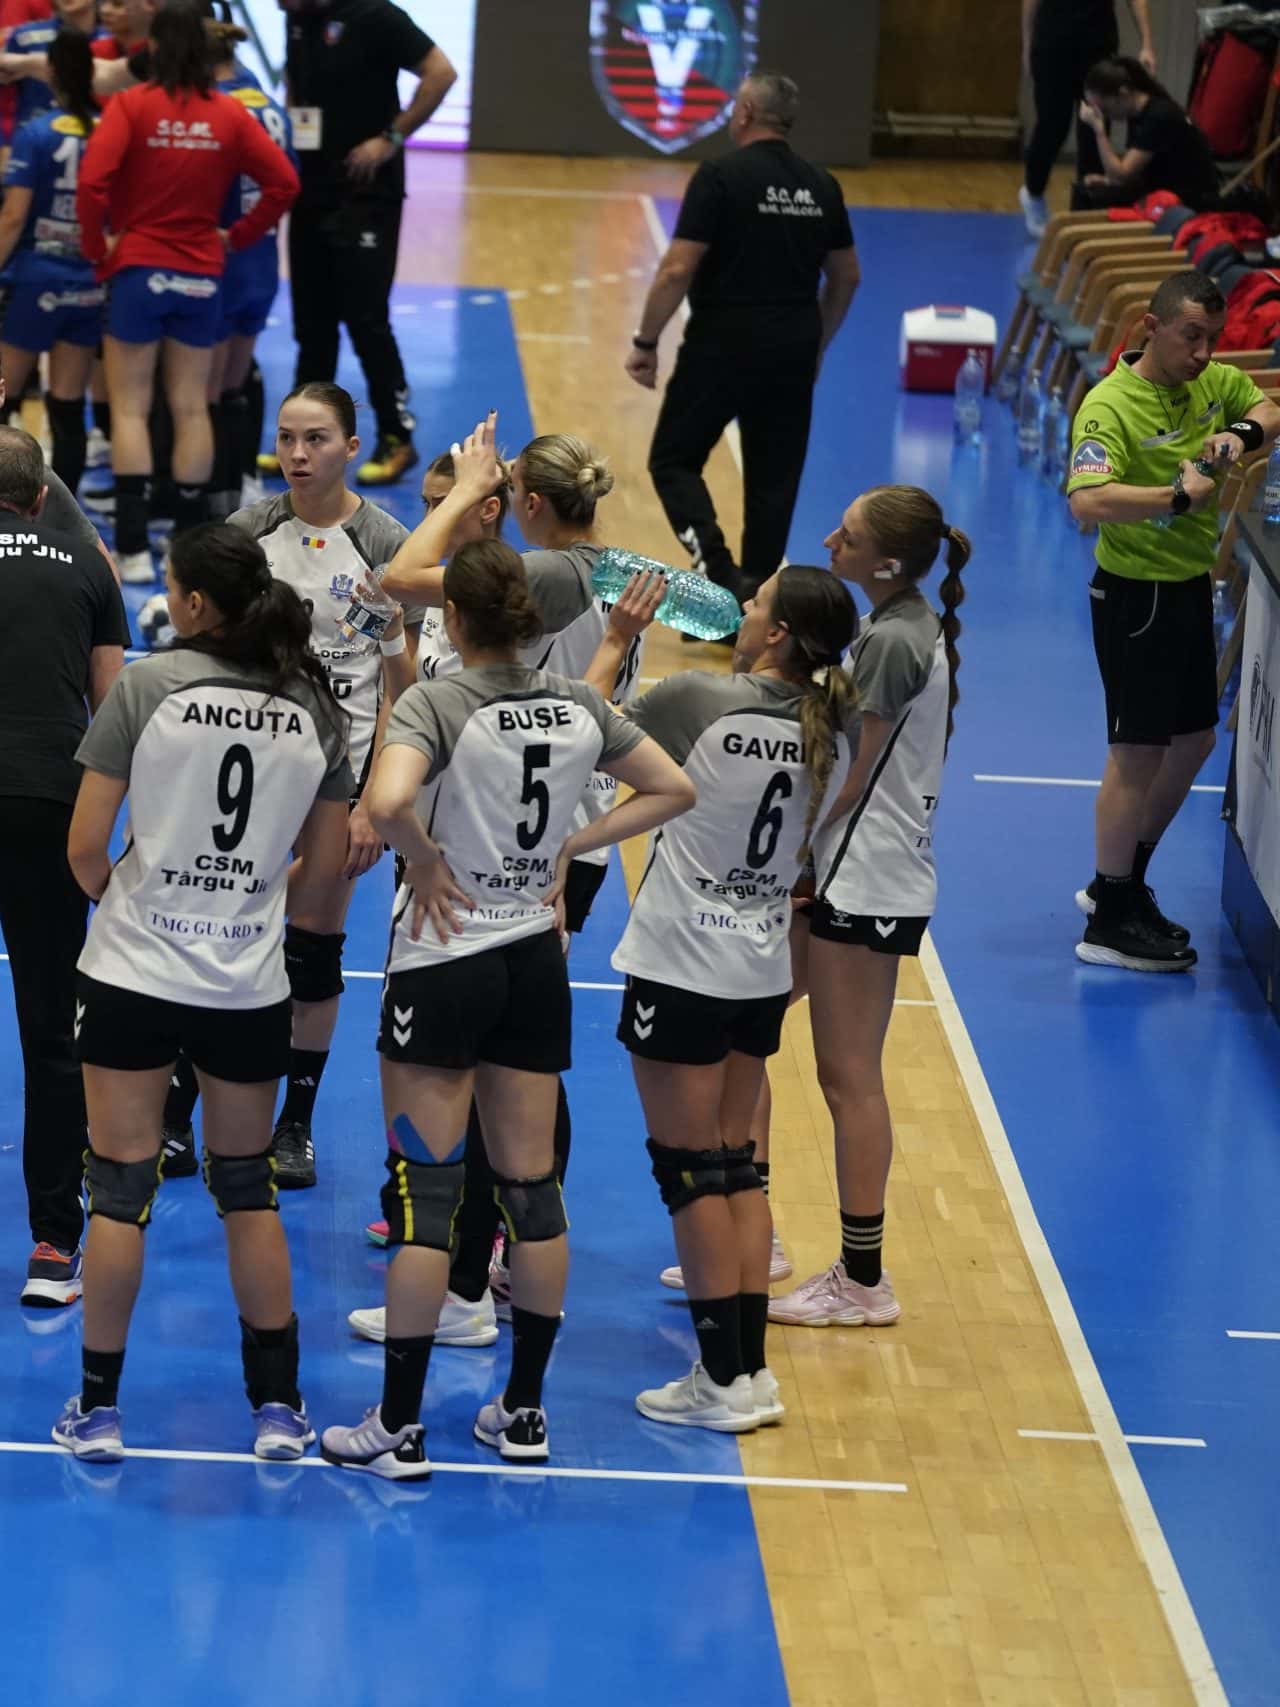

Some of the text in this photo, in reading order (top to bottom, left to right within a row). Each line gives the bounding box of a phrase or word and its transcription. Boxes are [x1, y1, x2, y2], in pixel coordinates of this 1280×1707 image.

[32, 547, 73, 563] Jiu
[182, 702, 302, 739] ANCUȚA
[499, 705, 572, 735] BUȘE
[211, 743, 254, 852] 9
[516, 744, 551, 851] 5
[746, 771, 792, 869] 6
[195, 855, 254, 876] CSM
[503, 856, 549, 873] CSM
[726, 868, 778, 886] CSM
[161, 868, 235, 892] Târgu
[150, 911, 251, 938] TMG GUARD
